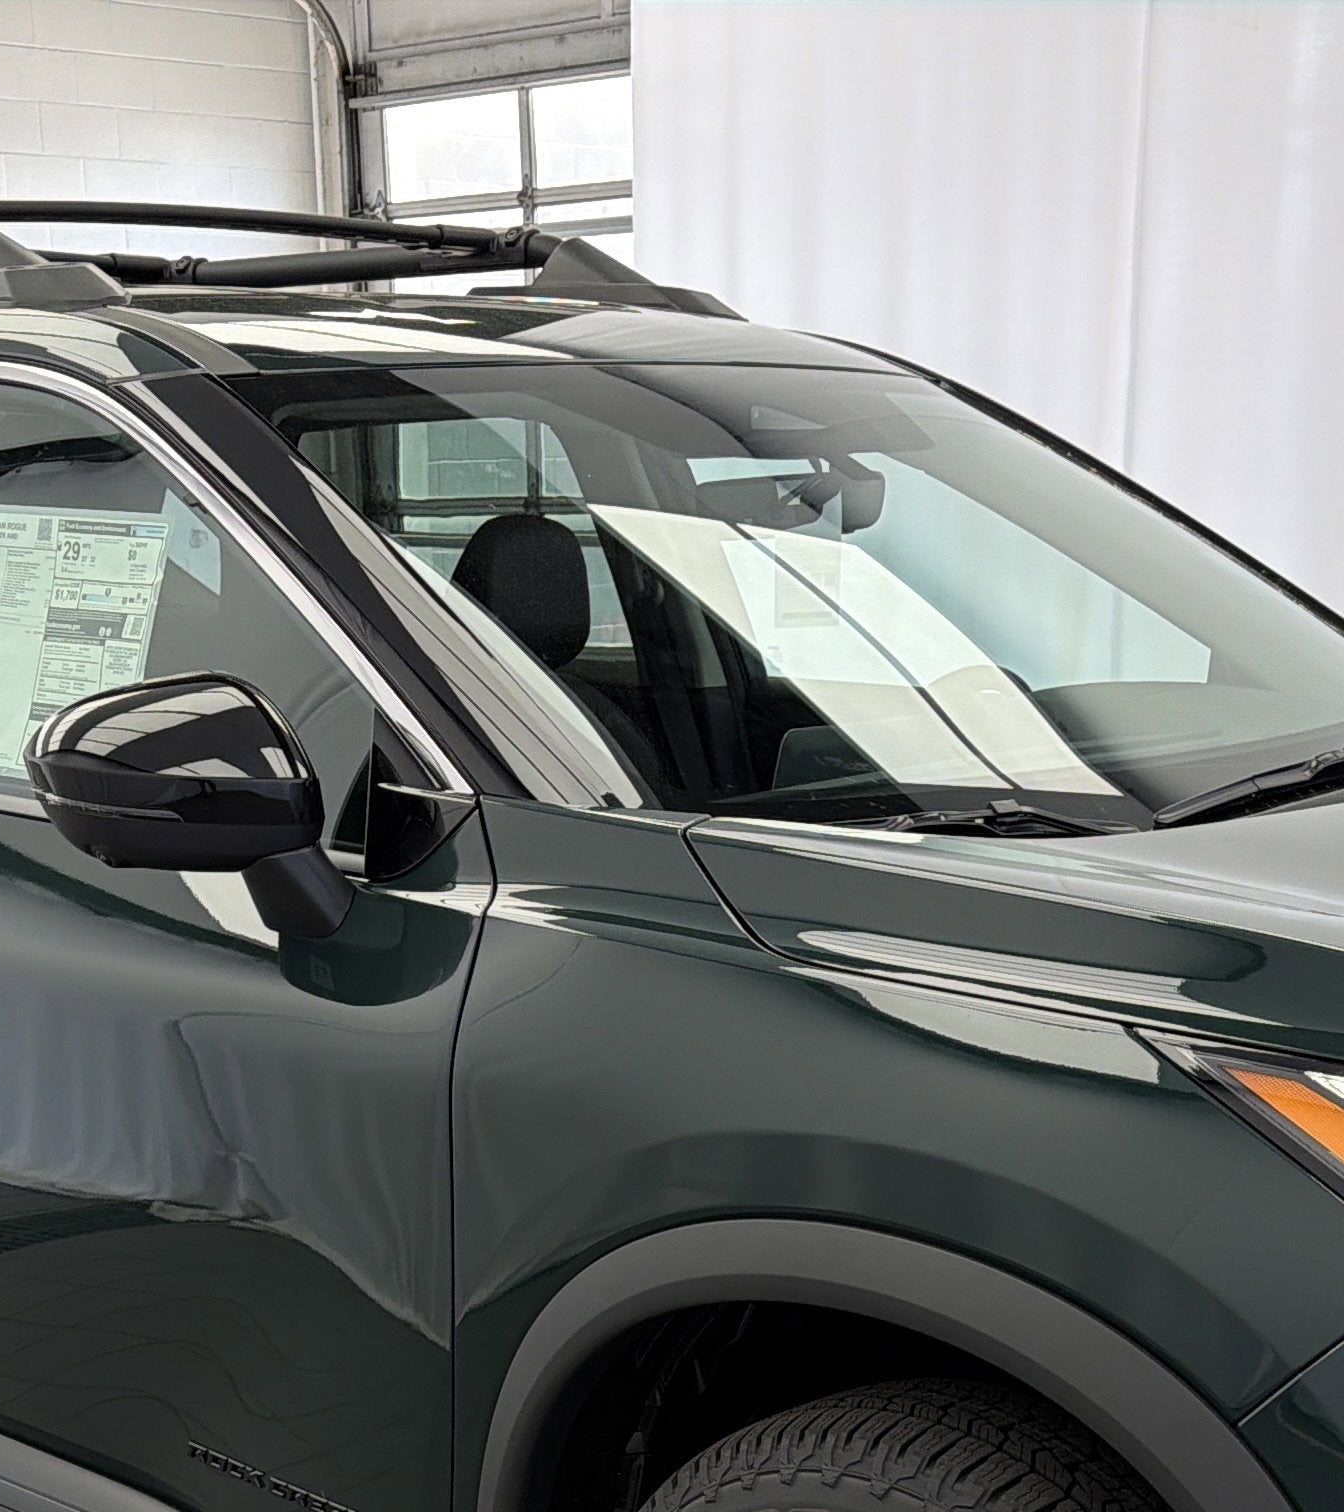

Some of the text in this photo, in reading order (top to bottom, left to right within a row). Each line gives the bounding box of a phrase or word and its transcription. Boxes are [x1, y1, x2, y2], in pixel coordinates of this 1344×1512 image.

[7, 521, 27, 531] ROGUE
[62, 540, 81, 561] 29
[54, 588, 78, 602] $1,700
